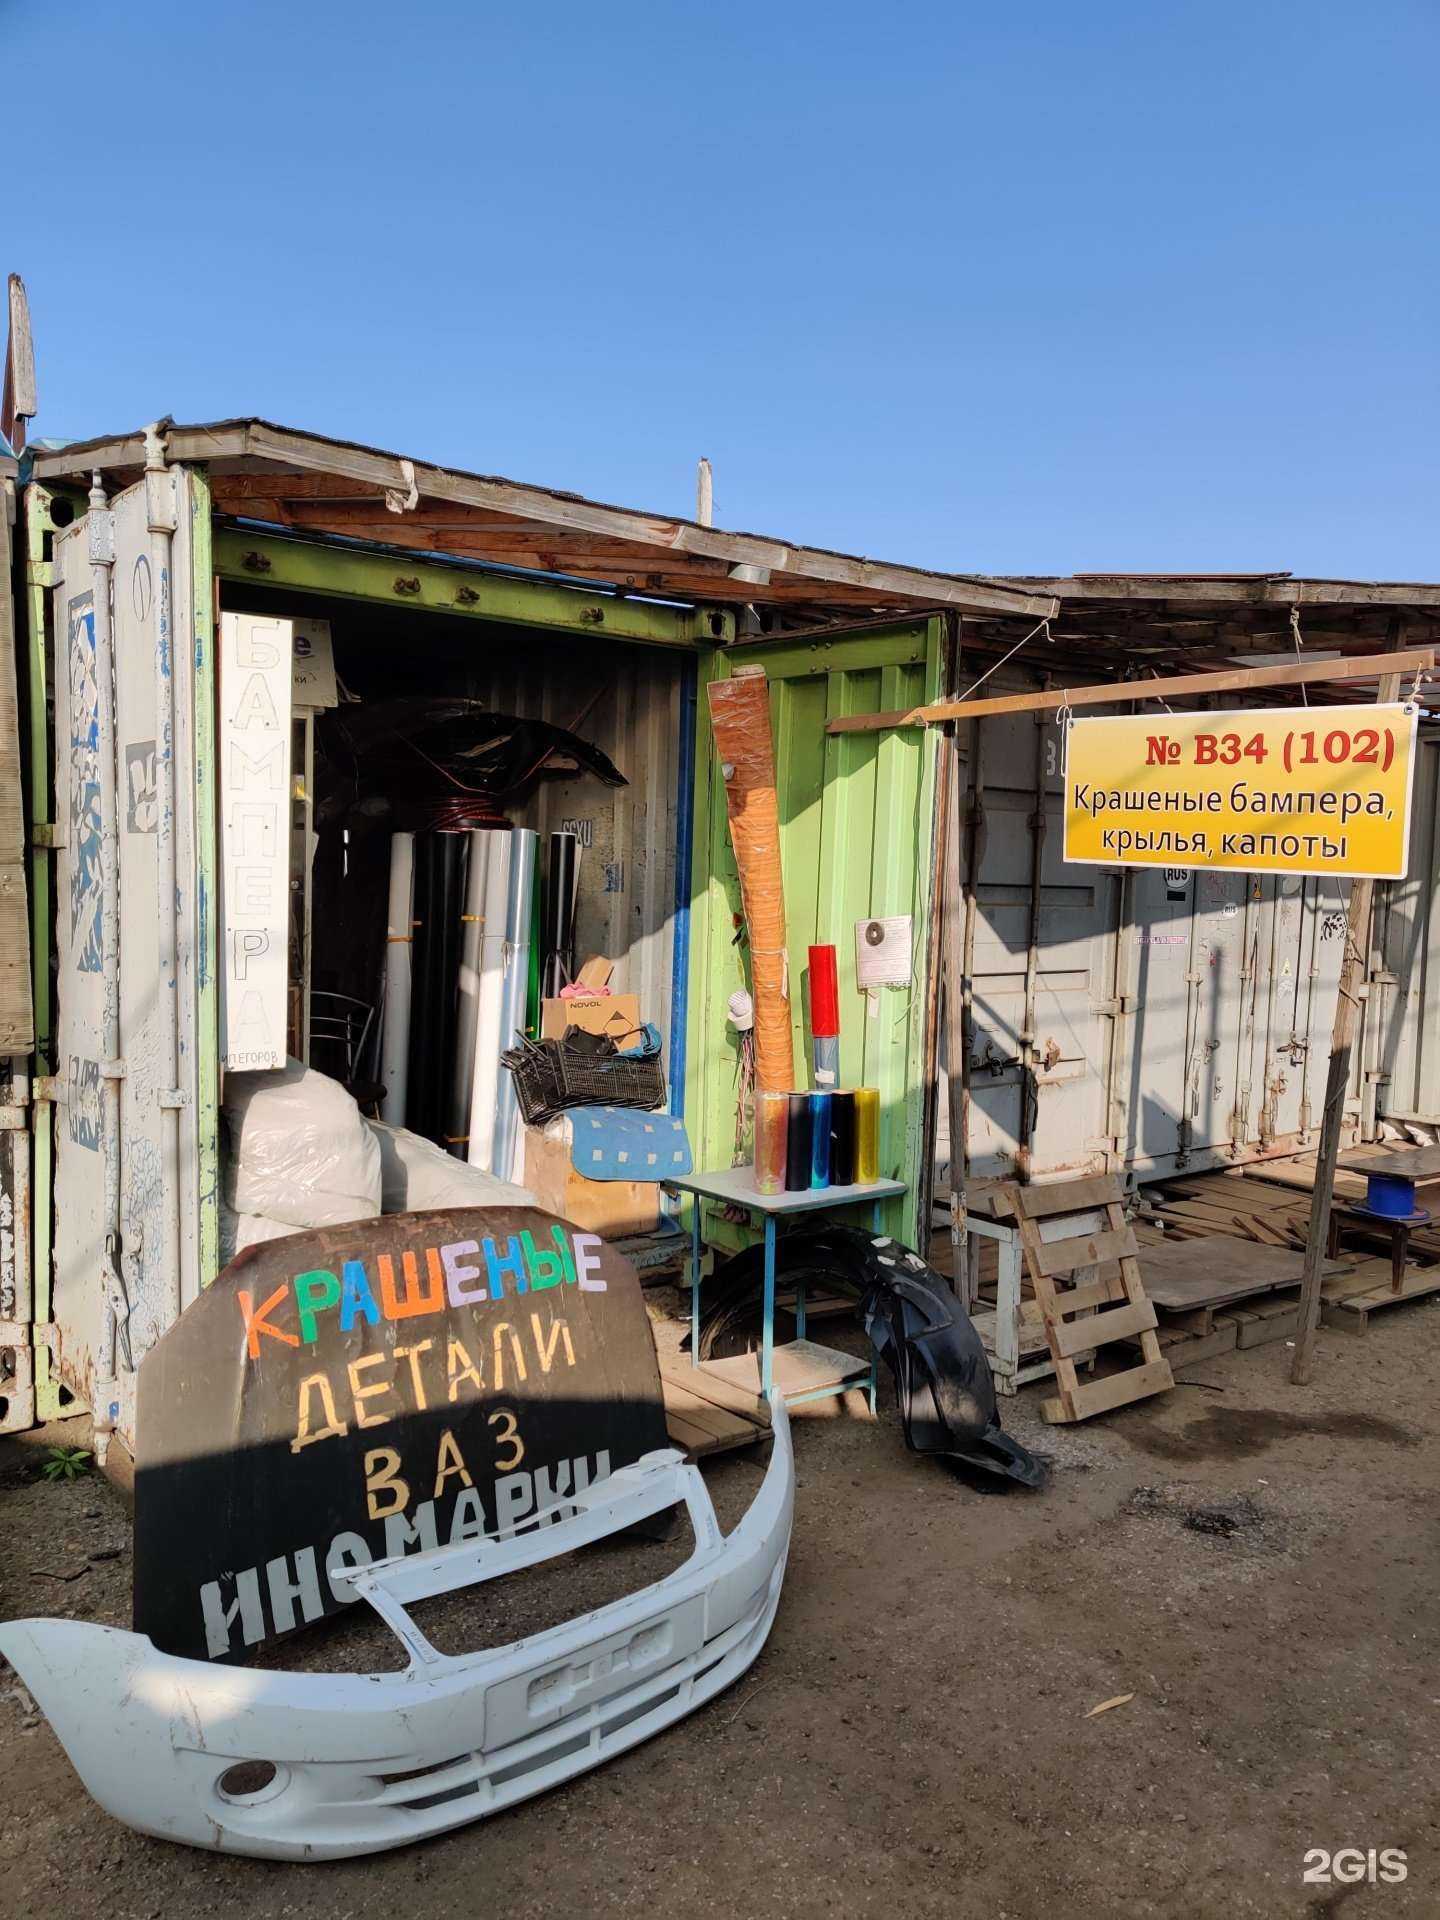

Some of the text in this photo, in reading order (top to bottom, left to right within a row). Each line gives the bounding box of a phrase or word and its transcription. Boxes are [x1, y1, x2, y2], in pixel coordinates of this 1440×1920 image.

[1145, 728, 1395, 774] № В34 (102)
[1073, 782, 1393, 825] Крашеные бампера,
[1102, 829, 1348, 859] крылья, капоты
[1167, 868, 1188, 881] RUS
[570, 1001, 601, 1009] NOVOL
[237, 1225, 608, 1360] КРАШЕНЫЕ
[291, 1313, 576, 1454] ДЕТАЛИ
